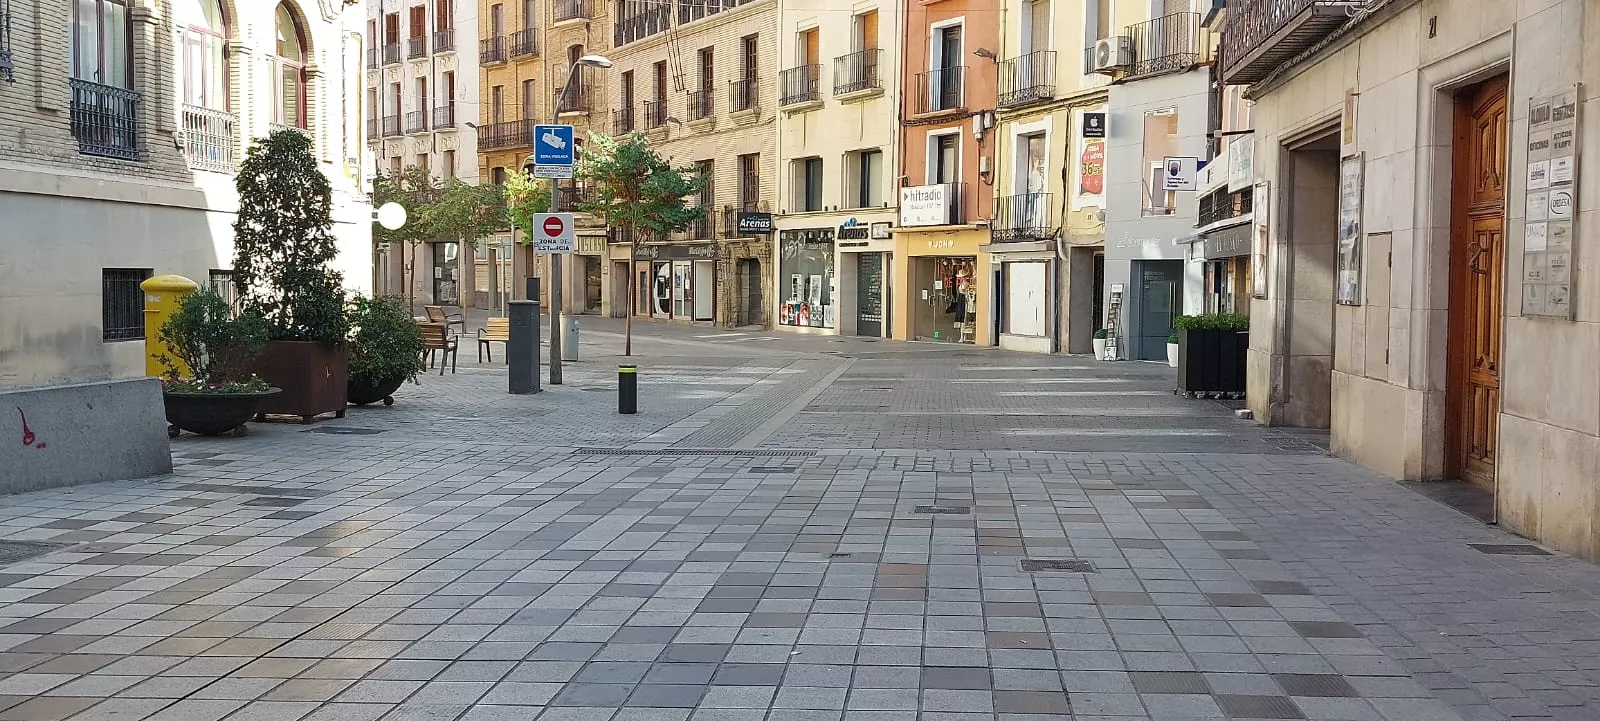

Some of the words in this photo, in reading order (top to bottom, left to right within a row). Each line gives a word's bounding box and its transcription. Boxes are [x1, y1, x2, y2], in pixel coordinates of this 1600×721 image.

[910, 189, 942, 201] hitradio
[739, 218, 771, 228] Arenas
[836, 224, 869, 239] Arenas
